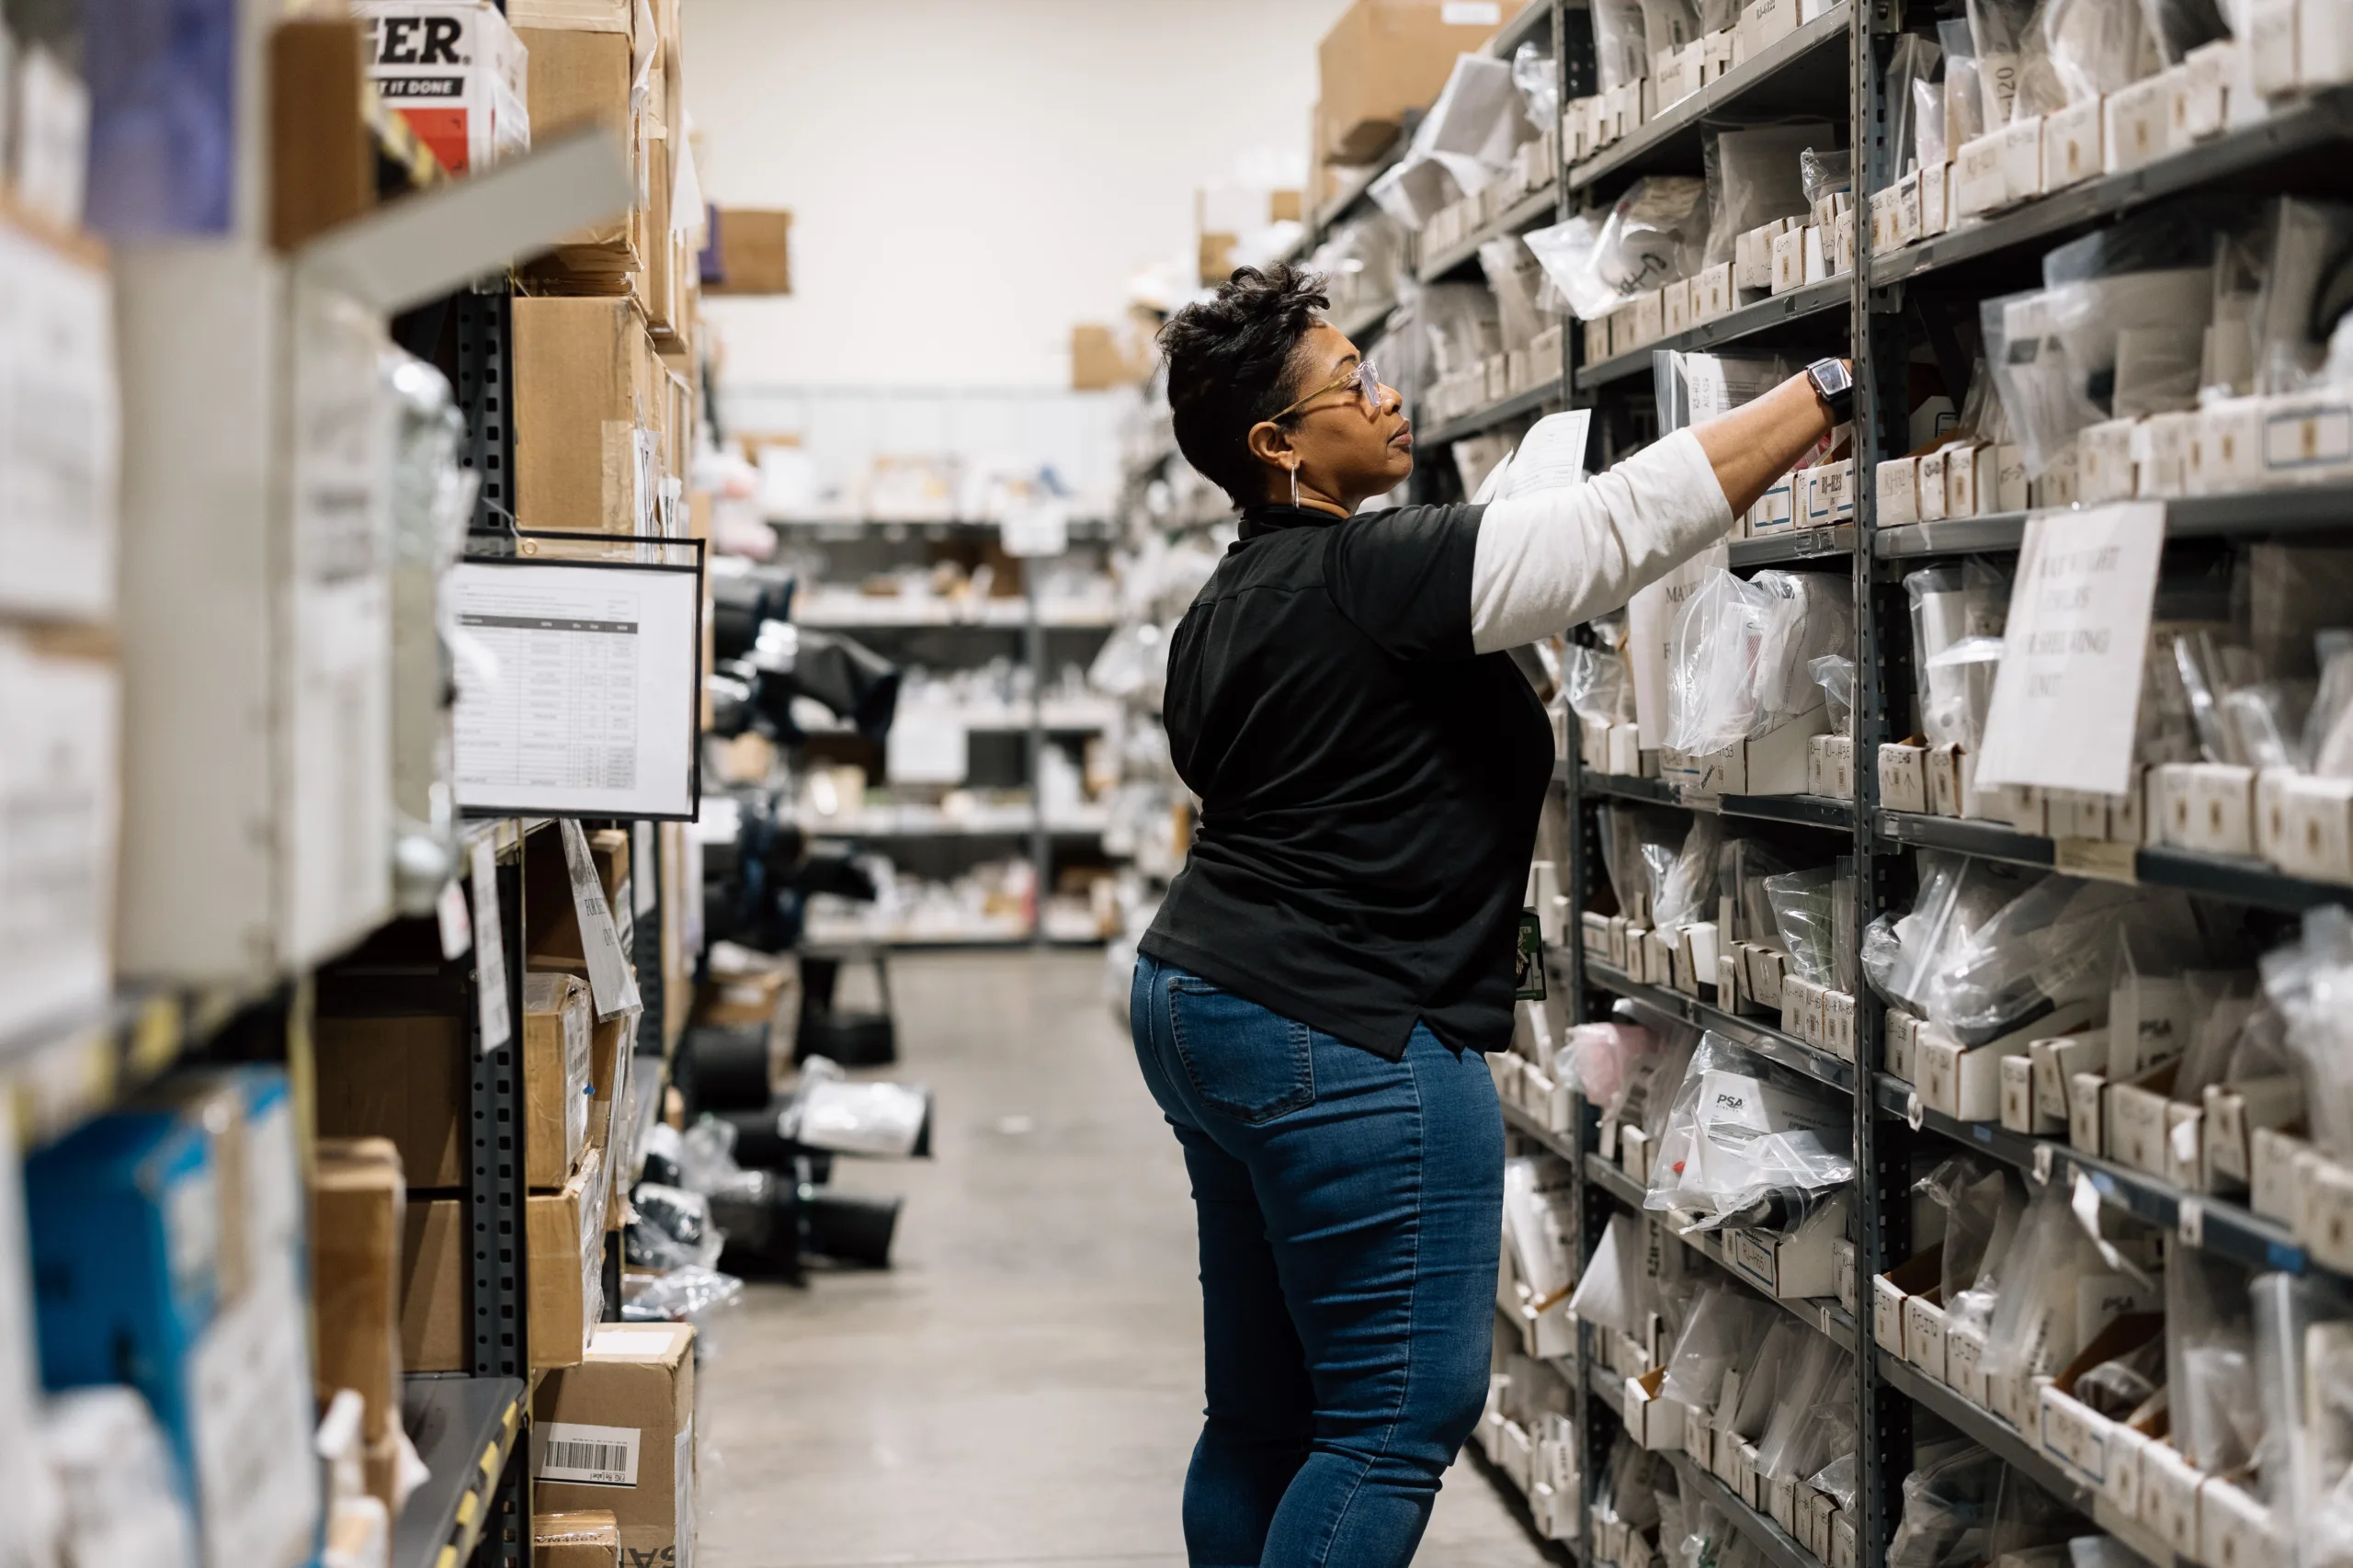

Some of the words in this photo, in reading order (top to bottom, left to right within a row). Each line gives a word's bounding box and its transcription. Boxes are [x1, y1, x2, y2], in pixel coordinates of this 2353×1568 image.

[407, 80, 454, 94] DONE
[1717, 1094, 1743, 1108] PSA
[589, 1471, 613, 1482] Relabel
[613, 1474, 626, 1483] FXG
